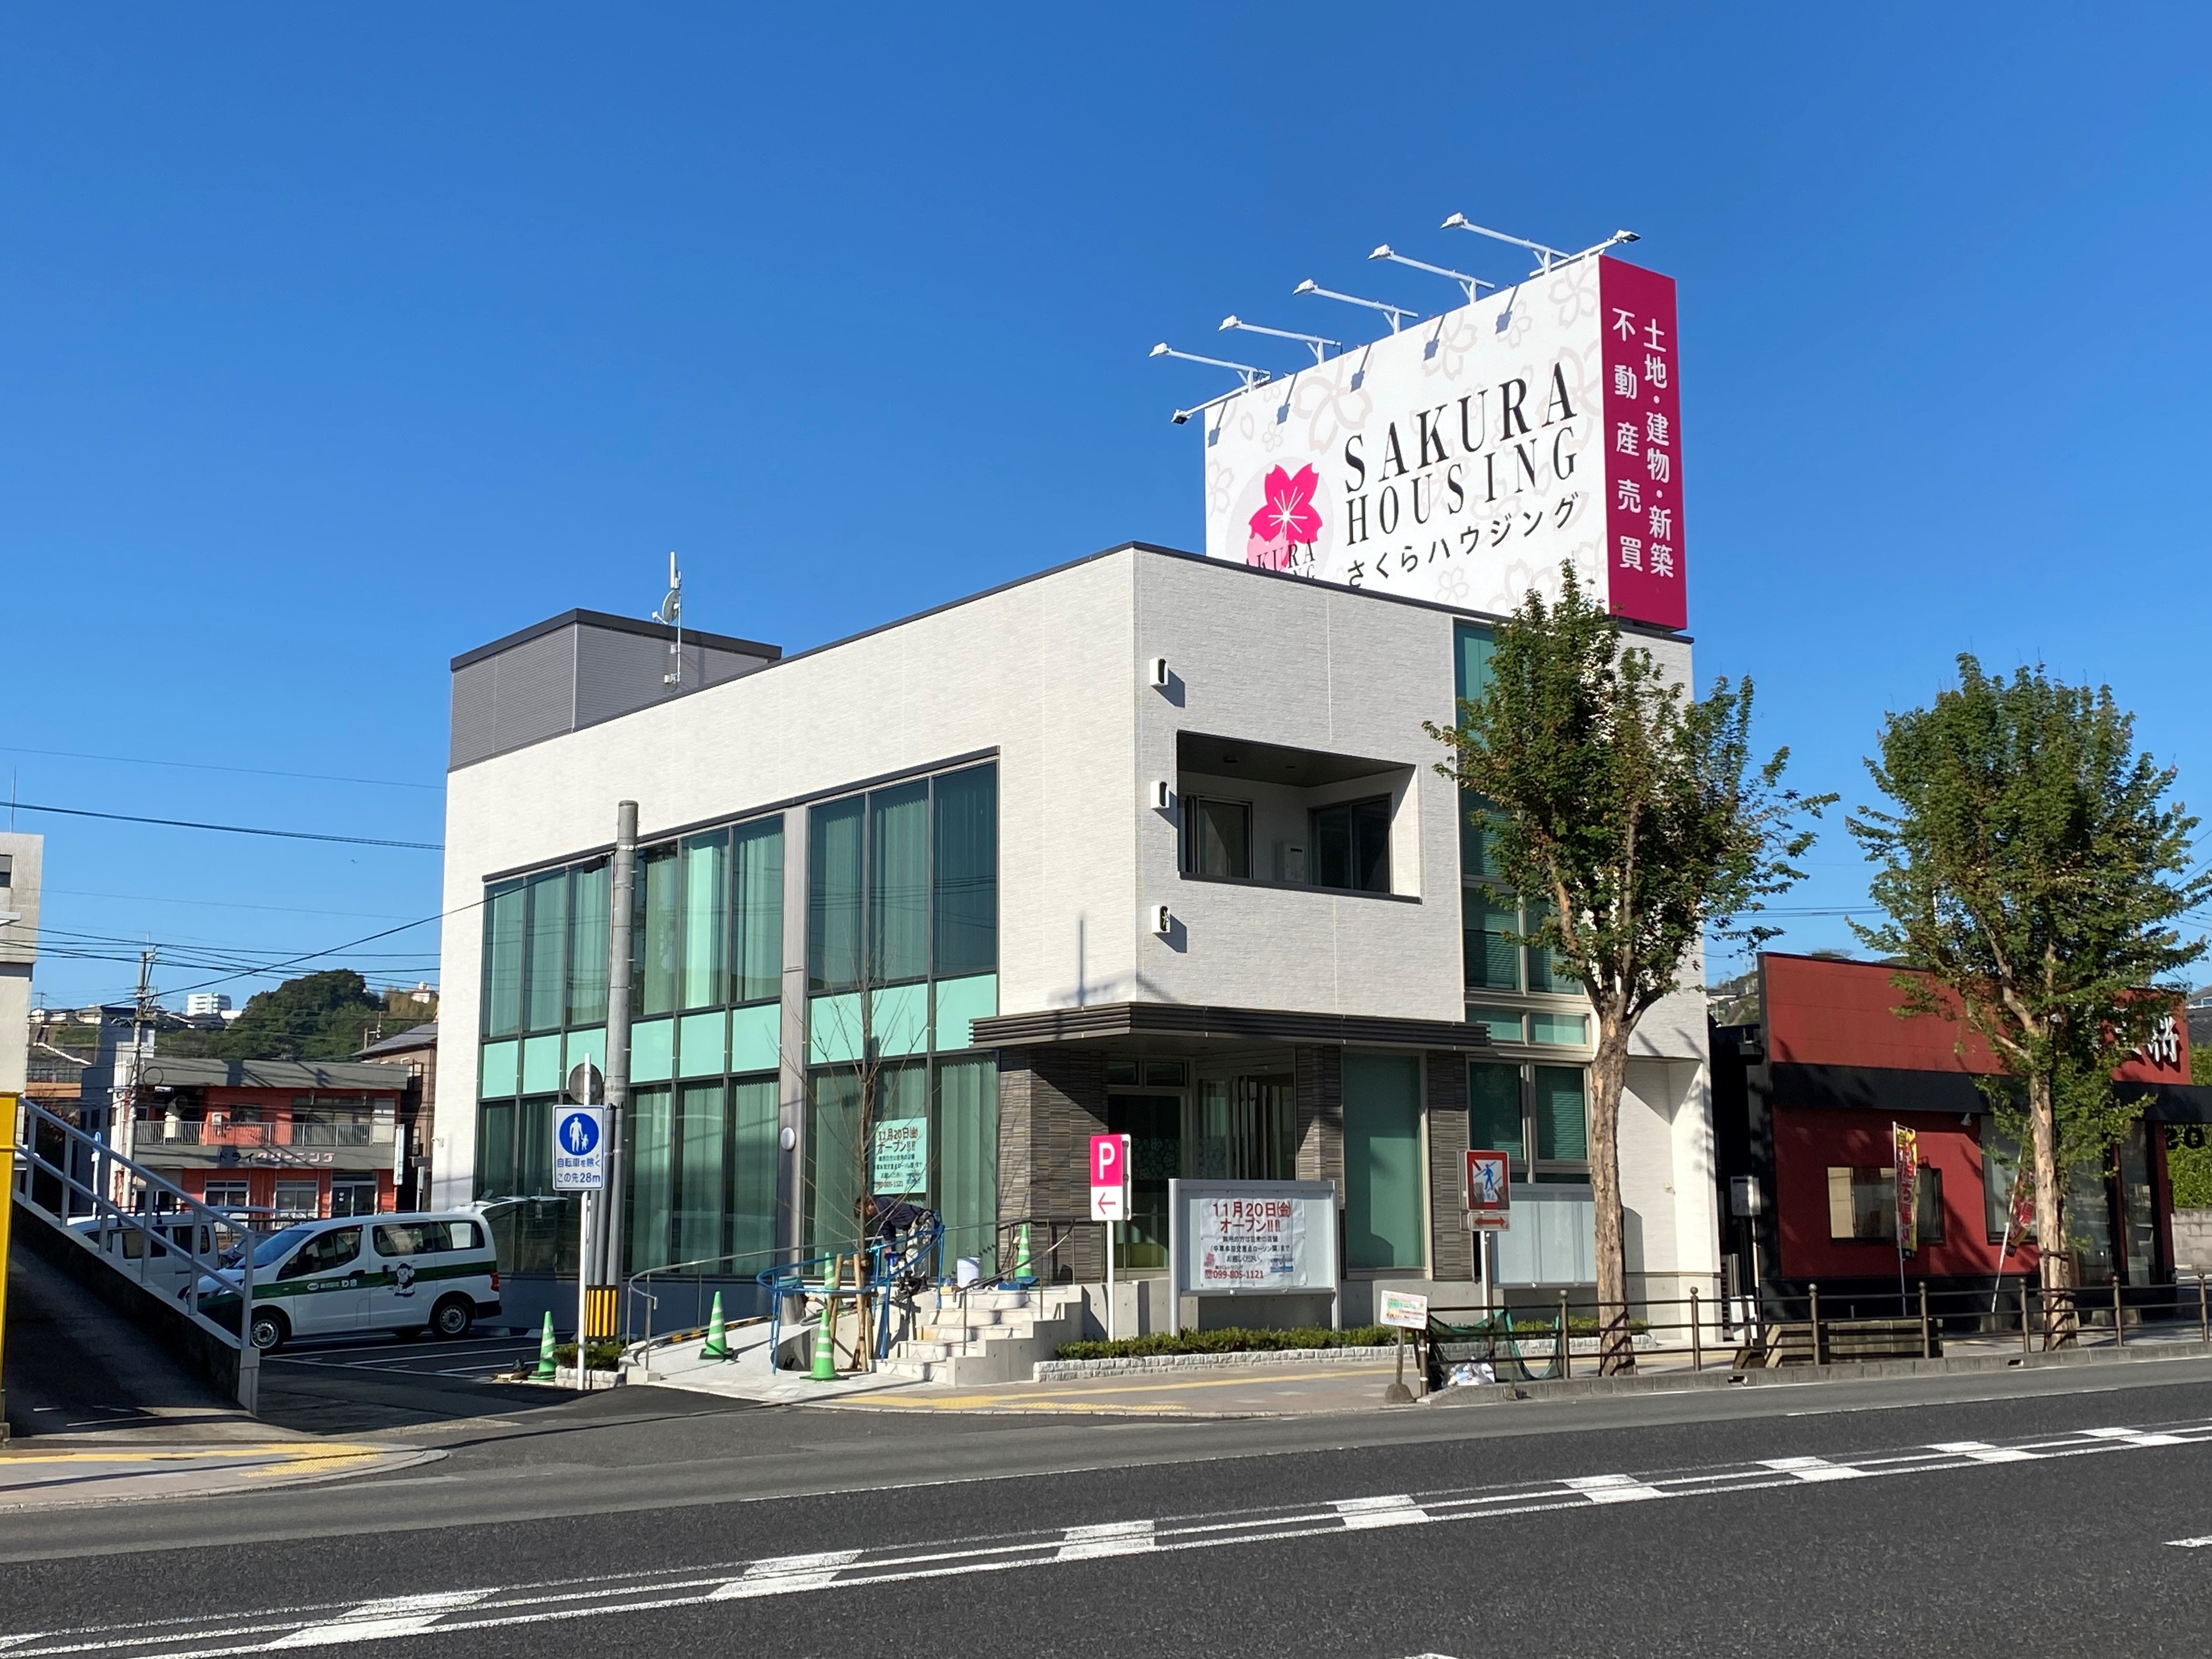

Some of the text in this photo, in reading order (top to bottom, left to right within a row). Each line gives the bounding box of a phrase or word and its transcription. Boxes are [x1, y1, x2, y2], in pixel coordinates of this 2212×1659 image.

[1345, 361, 1577, 493] SAKURA
[1612, 307, 1643, 572] 不動産売買
[1643, 318, 1674, 579] 土地・建物・新築
[1346, 426, 1577, 546] HOUSING
[1347, 491, 1579, 588] さくらハウジング
[219, 1151, 335, 1163] ドライクリーニング
[557, 1158, 600, 1167] 自転車を除く
[557, 1172, 600, 1183] この先28m
[1099, 1142, 1115, 1180] P
[1213, 1270, 1264, 1279] 099-805-1121
